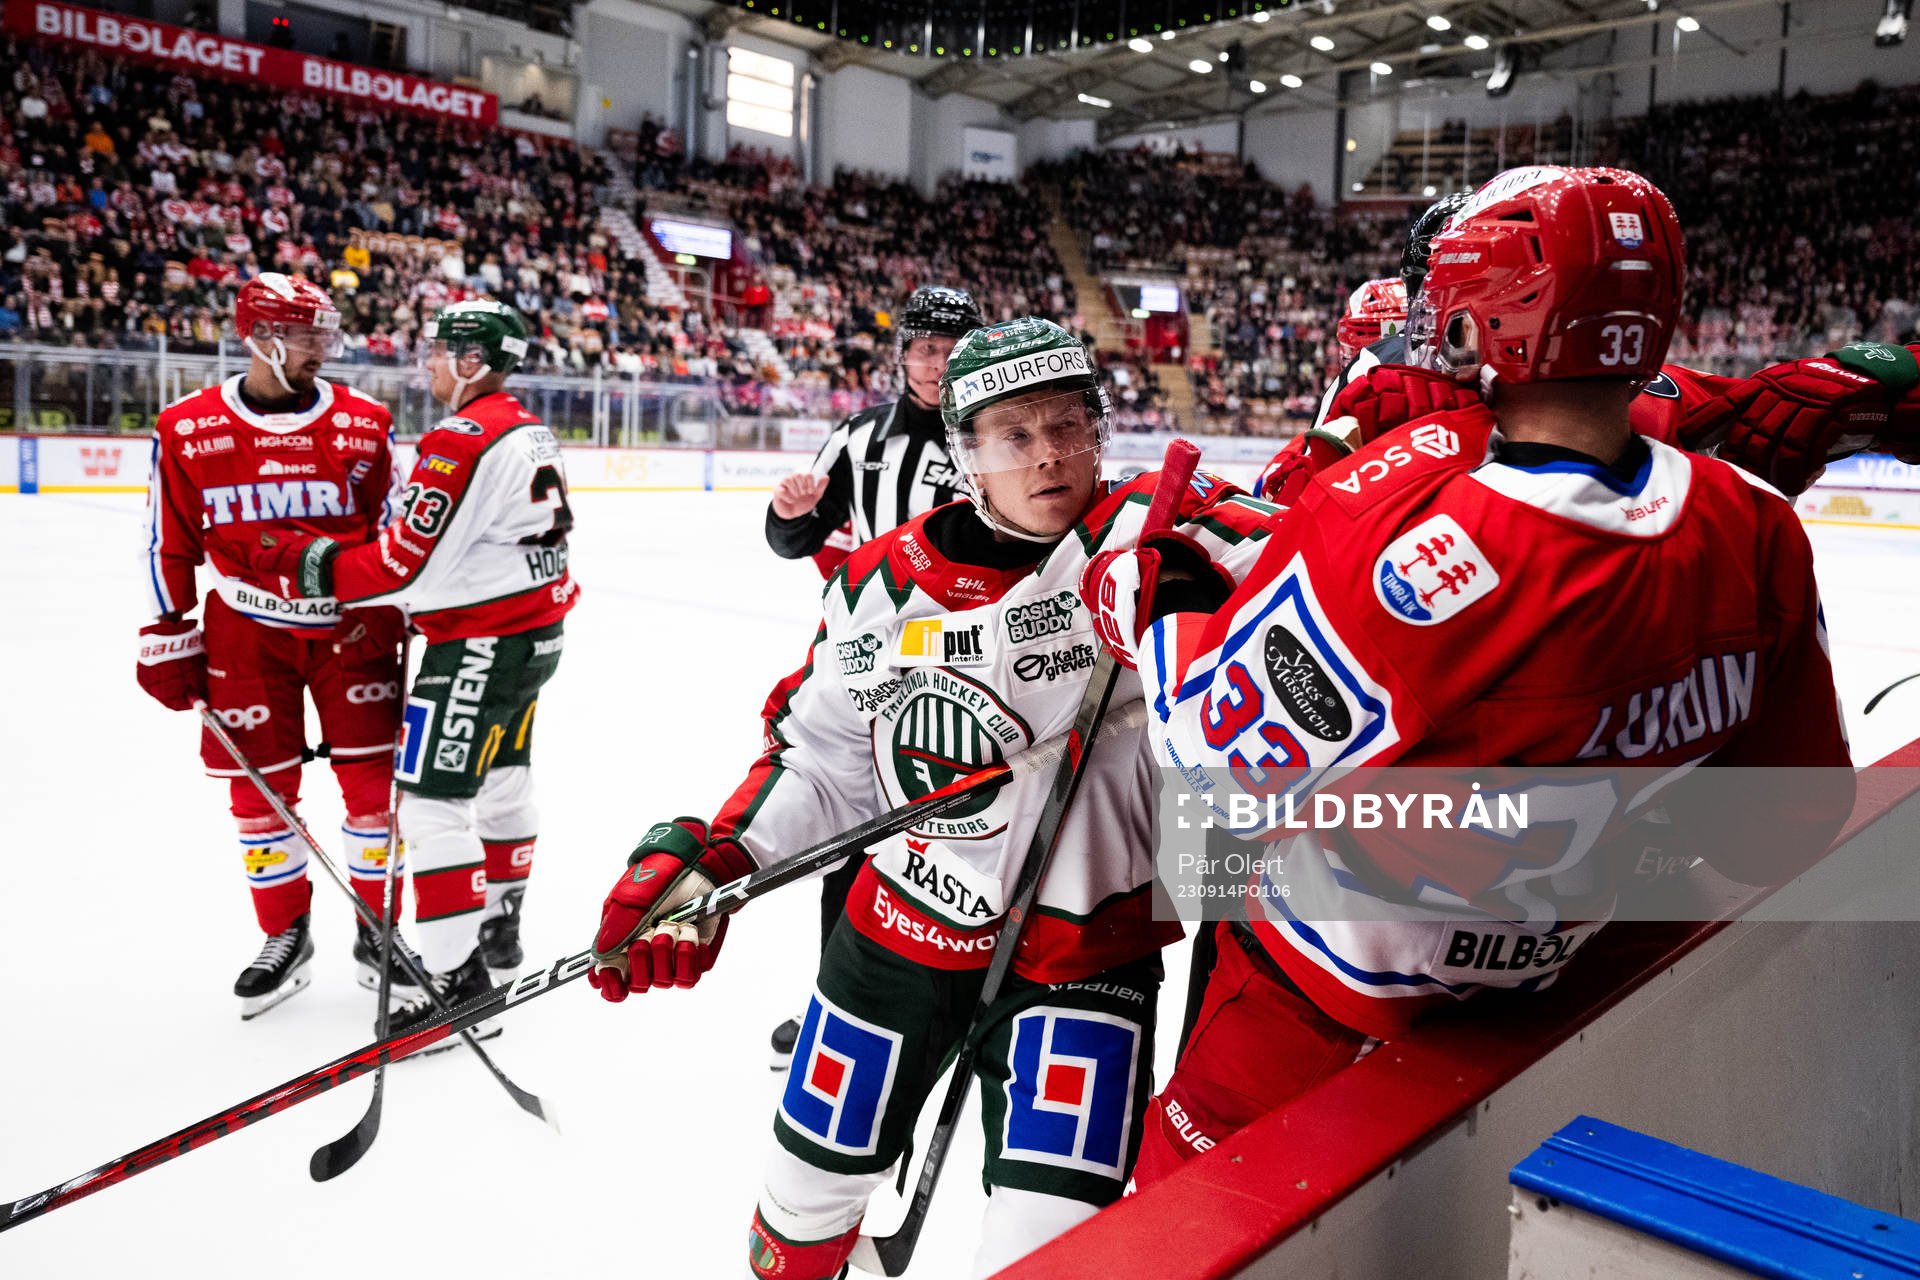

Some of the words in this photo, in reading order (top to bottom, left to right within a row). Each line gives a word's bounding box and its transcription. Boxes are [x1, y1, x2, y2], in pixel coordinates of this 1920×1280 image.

[35, 4, 265, 76] BILBOLAGET
[303, 60, 486, 119] BILBOLAGET
[931, 310, 962, 323] CCM
[1599, 324, 1646, 367] 33
[981, 349, 1086, 392] BJURFORS
[196, 415, 231, 430] SCA
[352, 415, 380, 431] SCA
[284, 464, 317, 475] NHC
[856, 461, 890, 471] CCM
[1332, 445, 1413, 495] SCA
[902, 543, 926, 573] SPORT
[909, 538, 932, 570] INTER
[954, 577, 987, 592] SHL
[1006, 600, 1057, 626] CASH
[1403, 600, 1418, 616] IK
[1010, 611, 1073, 643] BUDDY
[1045, 656, 1097, 681] greven
[1052, 644, 1094, 665] Kaffe
[441, 635, 500, 741] STENA
[1285, 648, 1323, 702] Yrkes
[1266, 646, 1332, 737] Mästaren
[933, 672, 990, 712] HOCKEY
[986, 711, 1020, 745] CLUB
[1199, 659, 1312, 804] 33
[1165, 737, 1200, 793] SUNDSVALLS
[901, 848, 998, 918] RASTA
